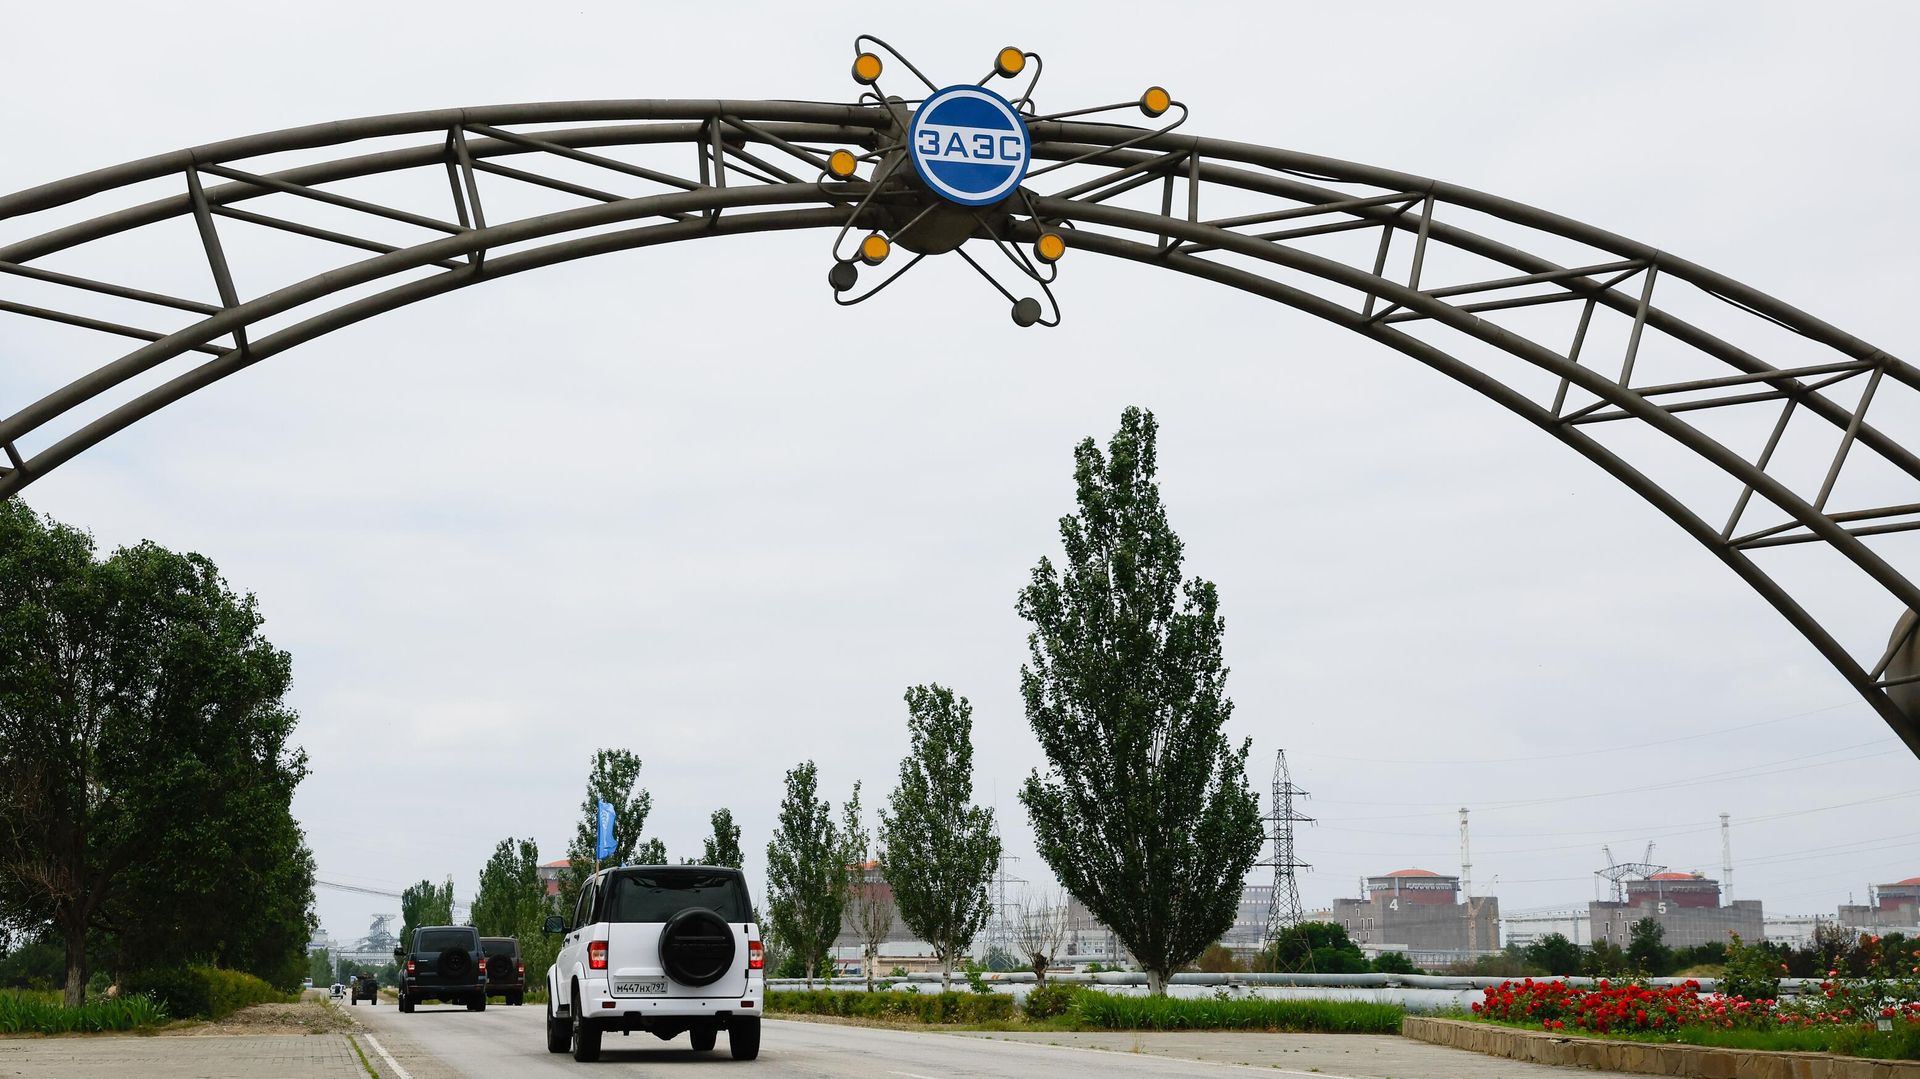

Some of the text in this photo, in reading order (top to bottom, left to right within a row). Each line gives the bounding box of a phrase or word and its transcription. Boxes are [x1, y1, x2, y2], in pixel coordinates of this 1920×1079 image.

[918, 130, 1021, 161] ЗАЭС
[1389, 898, 1399, 911] 4
[1657, 902, 1667, 914] 5
